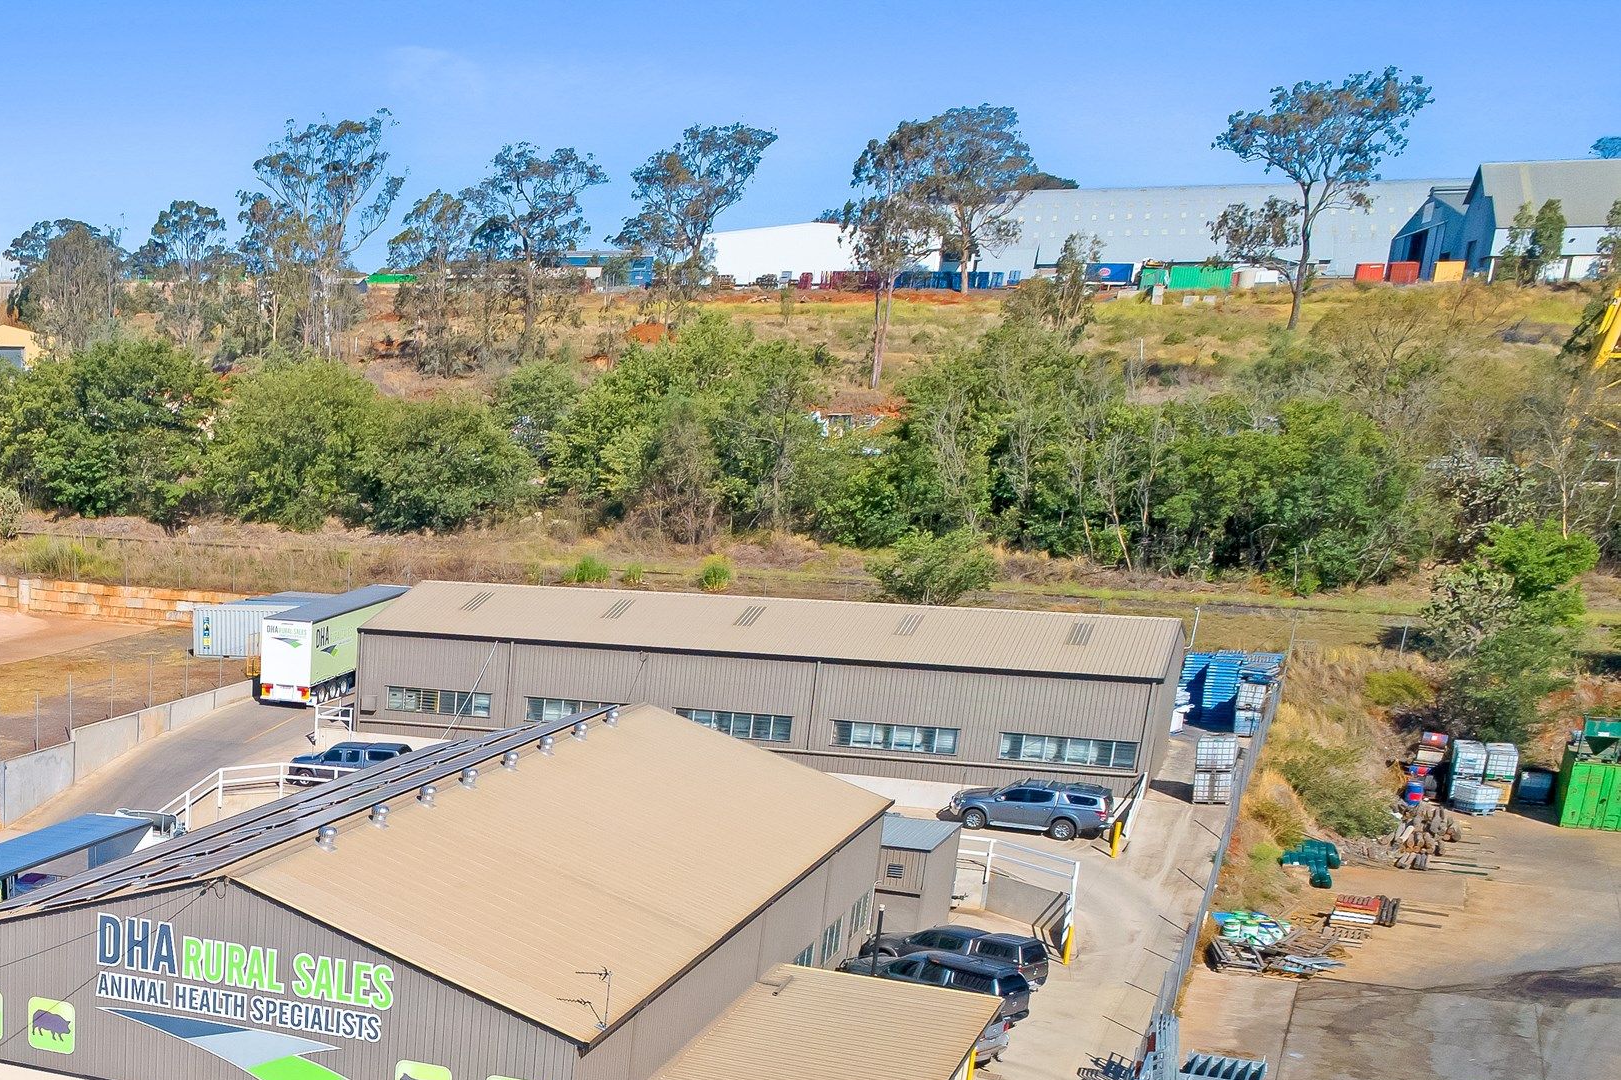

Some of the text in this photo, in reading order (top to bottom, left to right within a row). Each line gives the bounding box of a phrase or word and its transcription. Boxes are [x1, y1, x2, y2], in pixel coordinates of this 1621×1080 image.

[315, 626, 330, 649] DHA
[97, 912, 395, 1012] DHA RURAL SALES
[96, 971, 382, 1043] ANIMAL HEALTH SPECIALISTS
